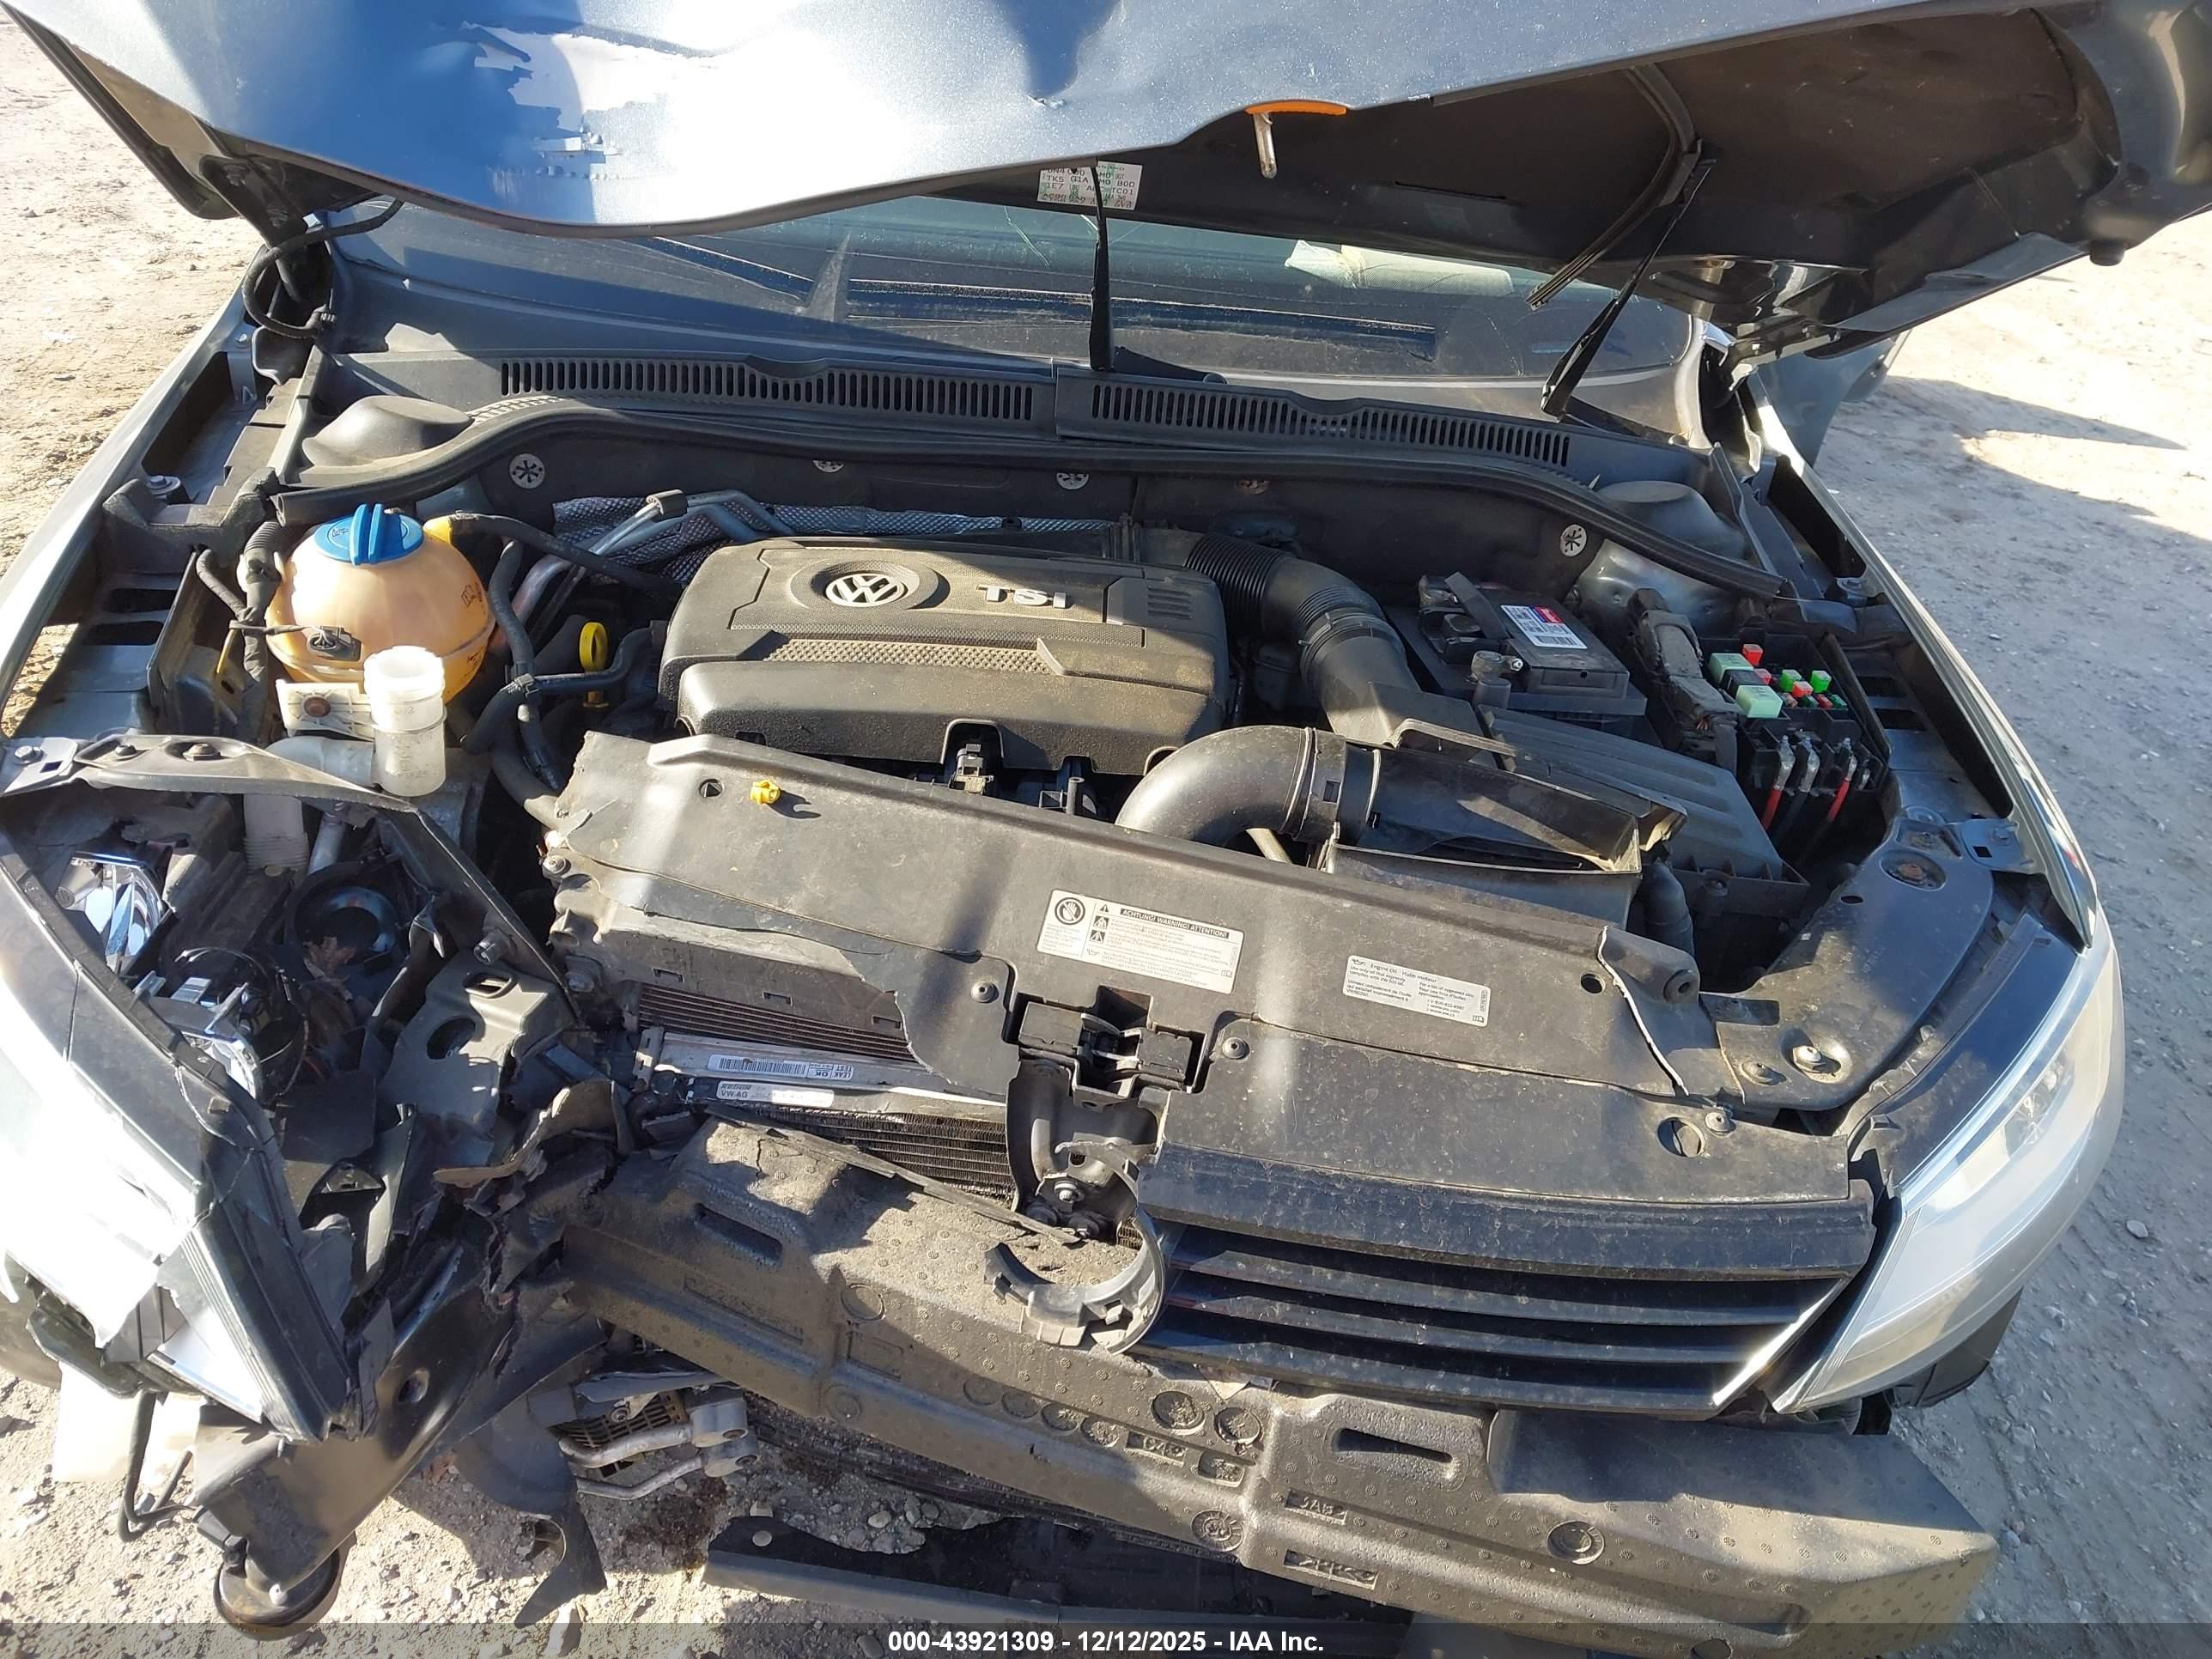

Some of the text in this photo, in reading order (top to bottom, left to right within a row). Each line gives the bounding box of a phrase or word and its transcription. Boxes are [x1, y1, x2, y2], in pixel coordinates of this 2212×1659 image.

[976, 584, 1067, 609] TSI
[1121, 908, 1229, 939] ACHTUNG! WARNING! ATTENTION!
[1370, 963, 1389, 972] Engine
